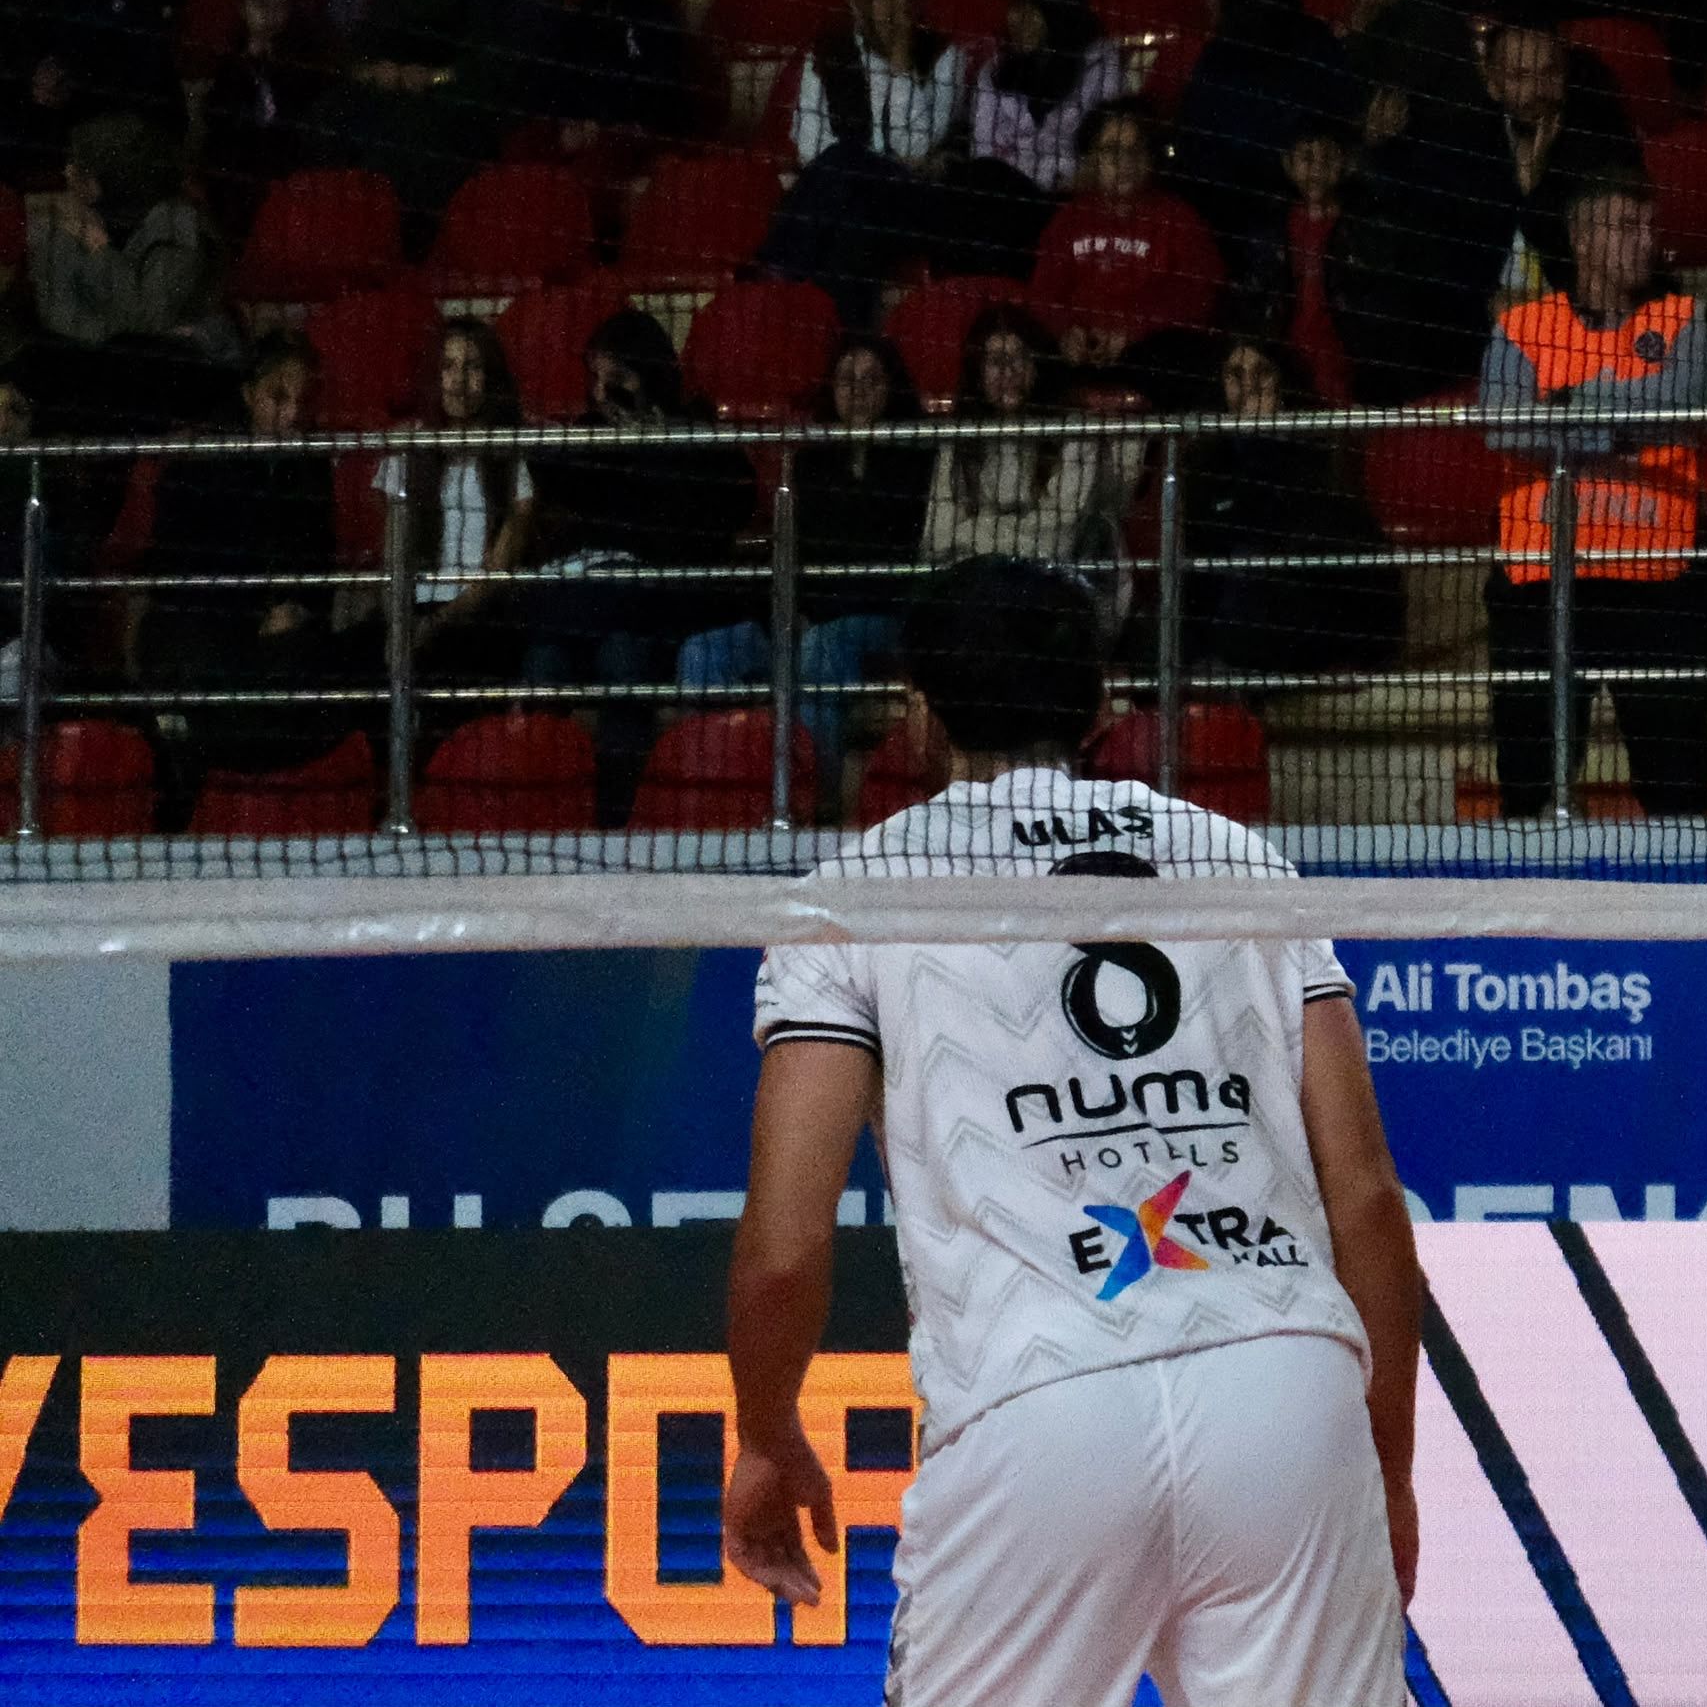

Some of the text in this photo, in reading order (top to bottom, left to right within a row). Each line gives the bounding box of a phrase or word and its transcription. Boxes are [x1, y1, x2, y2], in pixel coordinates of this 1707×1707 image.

[1366, 962, 1652, 1024] Ali Tombaş
[1366, 1027, 1653, 1070] Belediye Başkanı
[1004, 1069, 1251, 1134] numa
